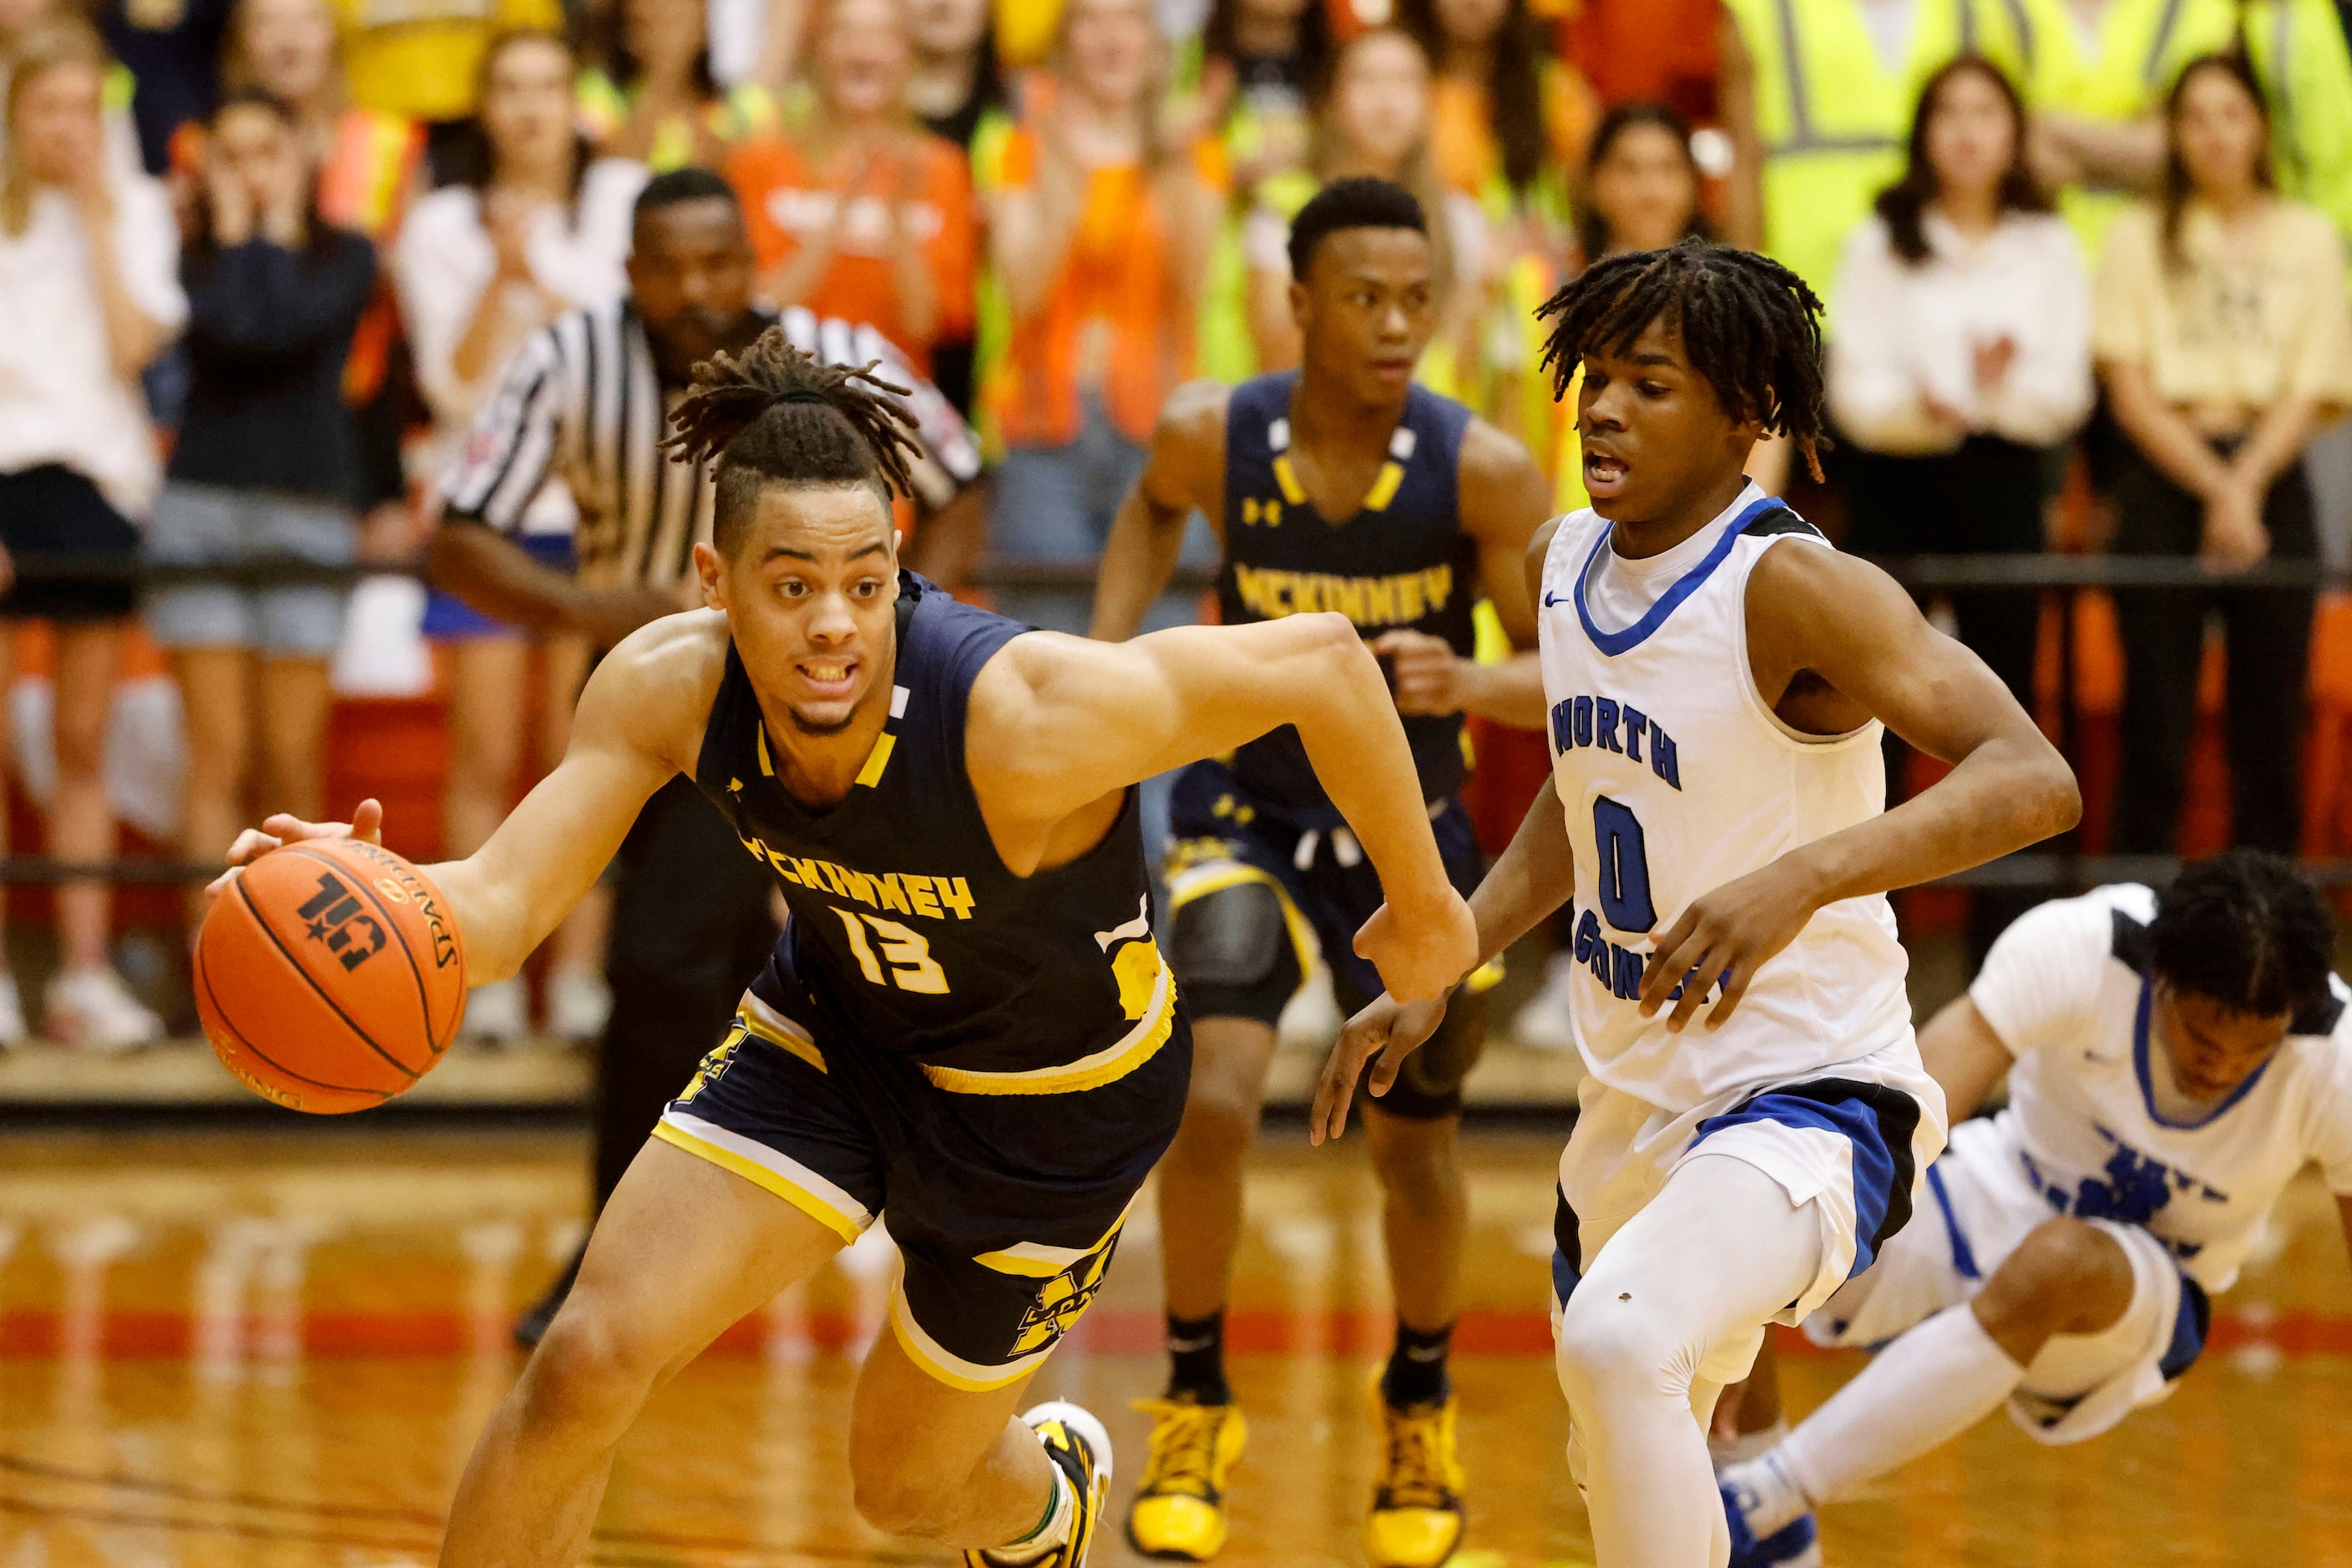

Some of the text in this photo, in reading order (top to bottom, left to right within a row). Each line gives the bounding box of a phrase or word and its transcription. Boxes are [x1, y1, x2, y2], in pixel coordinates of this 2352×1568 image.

[1551, 695, 1682, 792] NORTH
[1593, 794, 1657, 933] 0
[296, 872, 387, 973] UIL
[827, 905, 951, 994] 13
